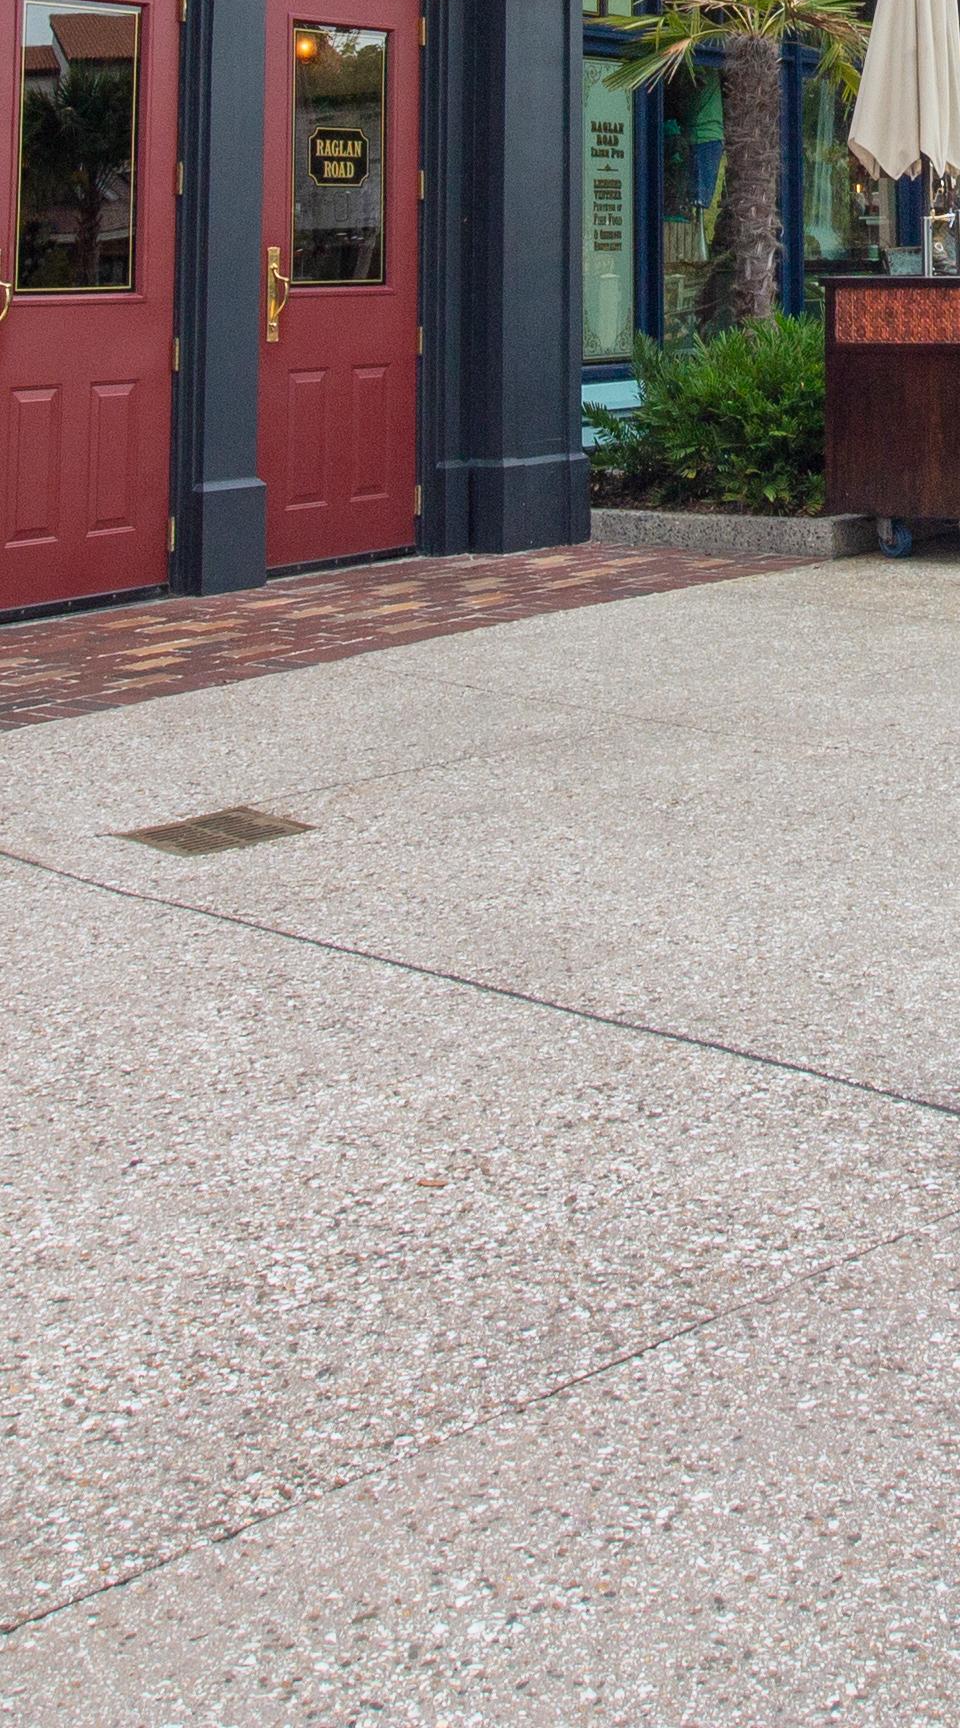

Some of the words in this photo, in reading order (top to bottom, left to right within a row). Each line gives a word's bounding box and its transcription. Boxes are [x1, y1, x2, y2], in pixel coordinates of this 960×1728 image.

[591, 121, 625, 135] RAGLAN
[596, 134, 619, 147] ROAD
[316, 140, 362, 157] RAGLAN
[323, 161, 354, 178] ROAD
